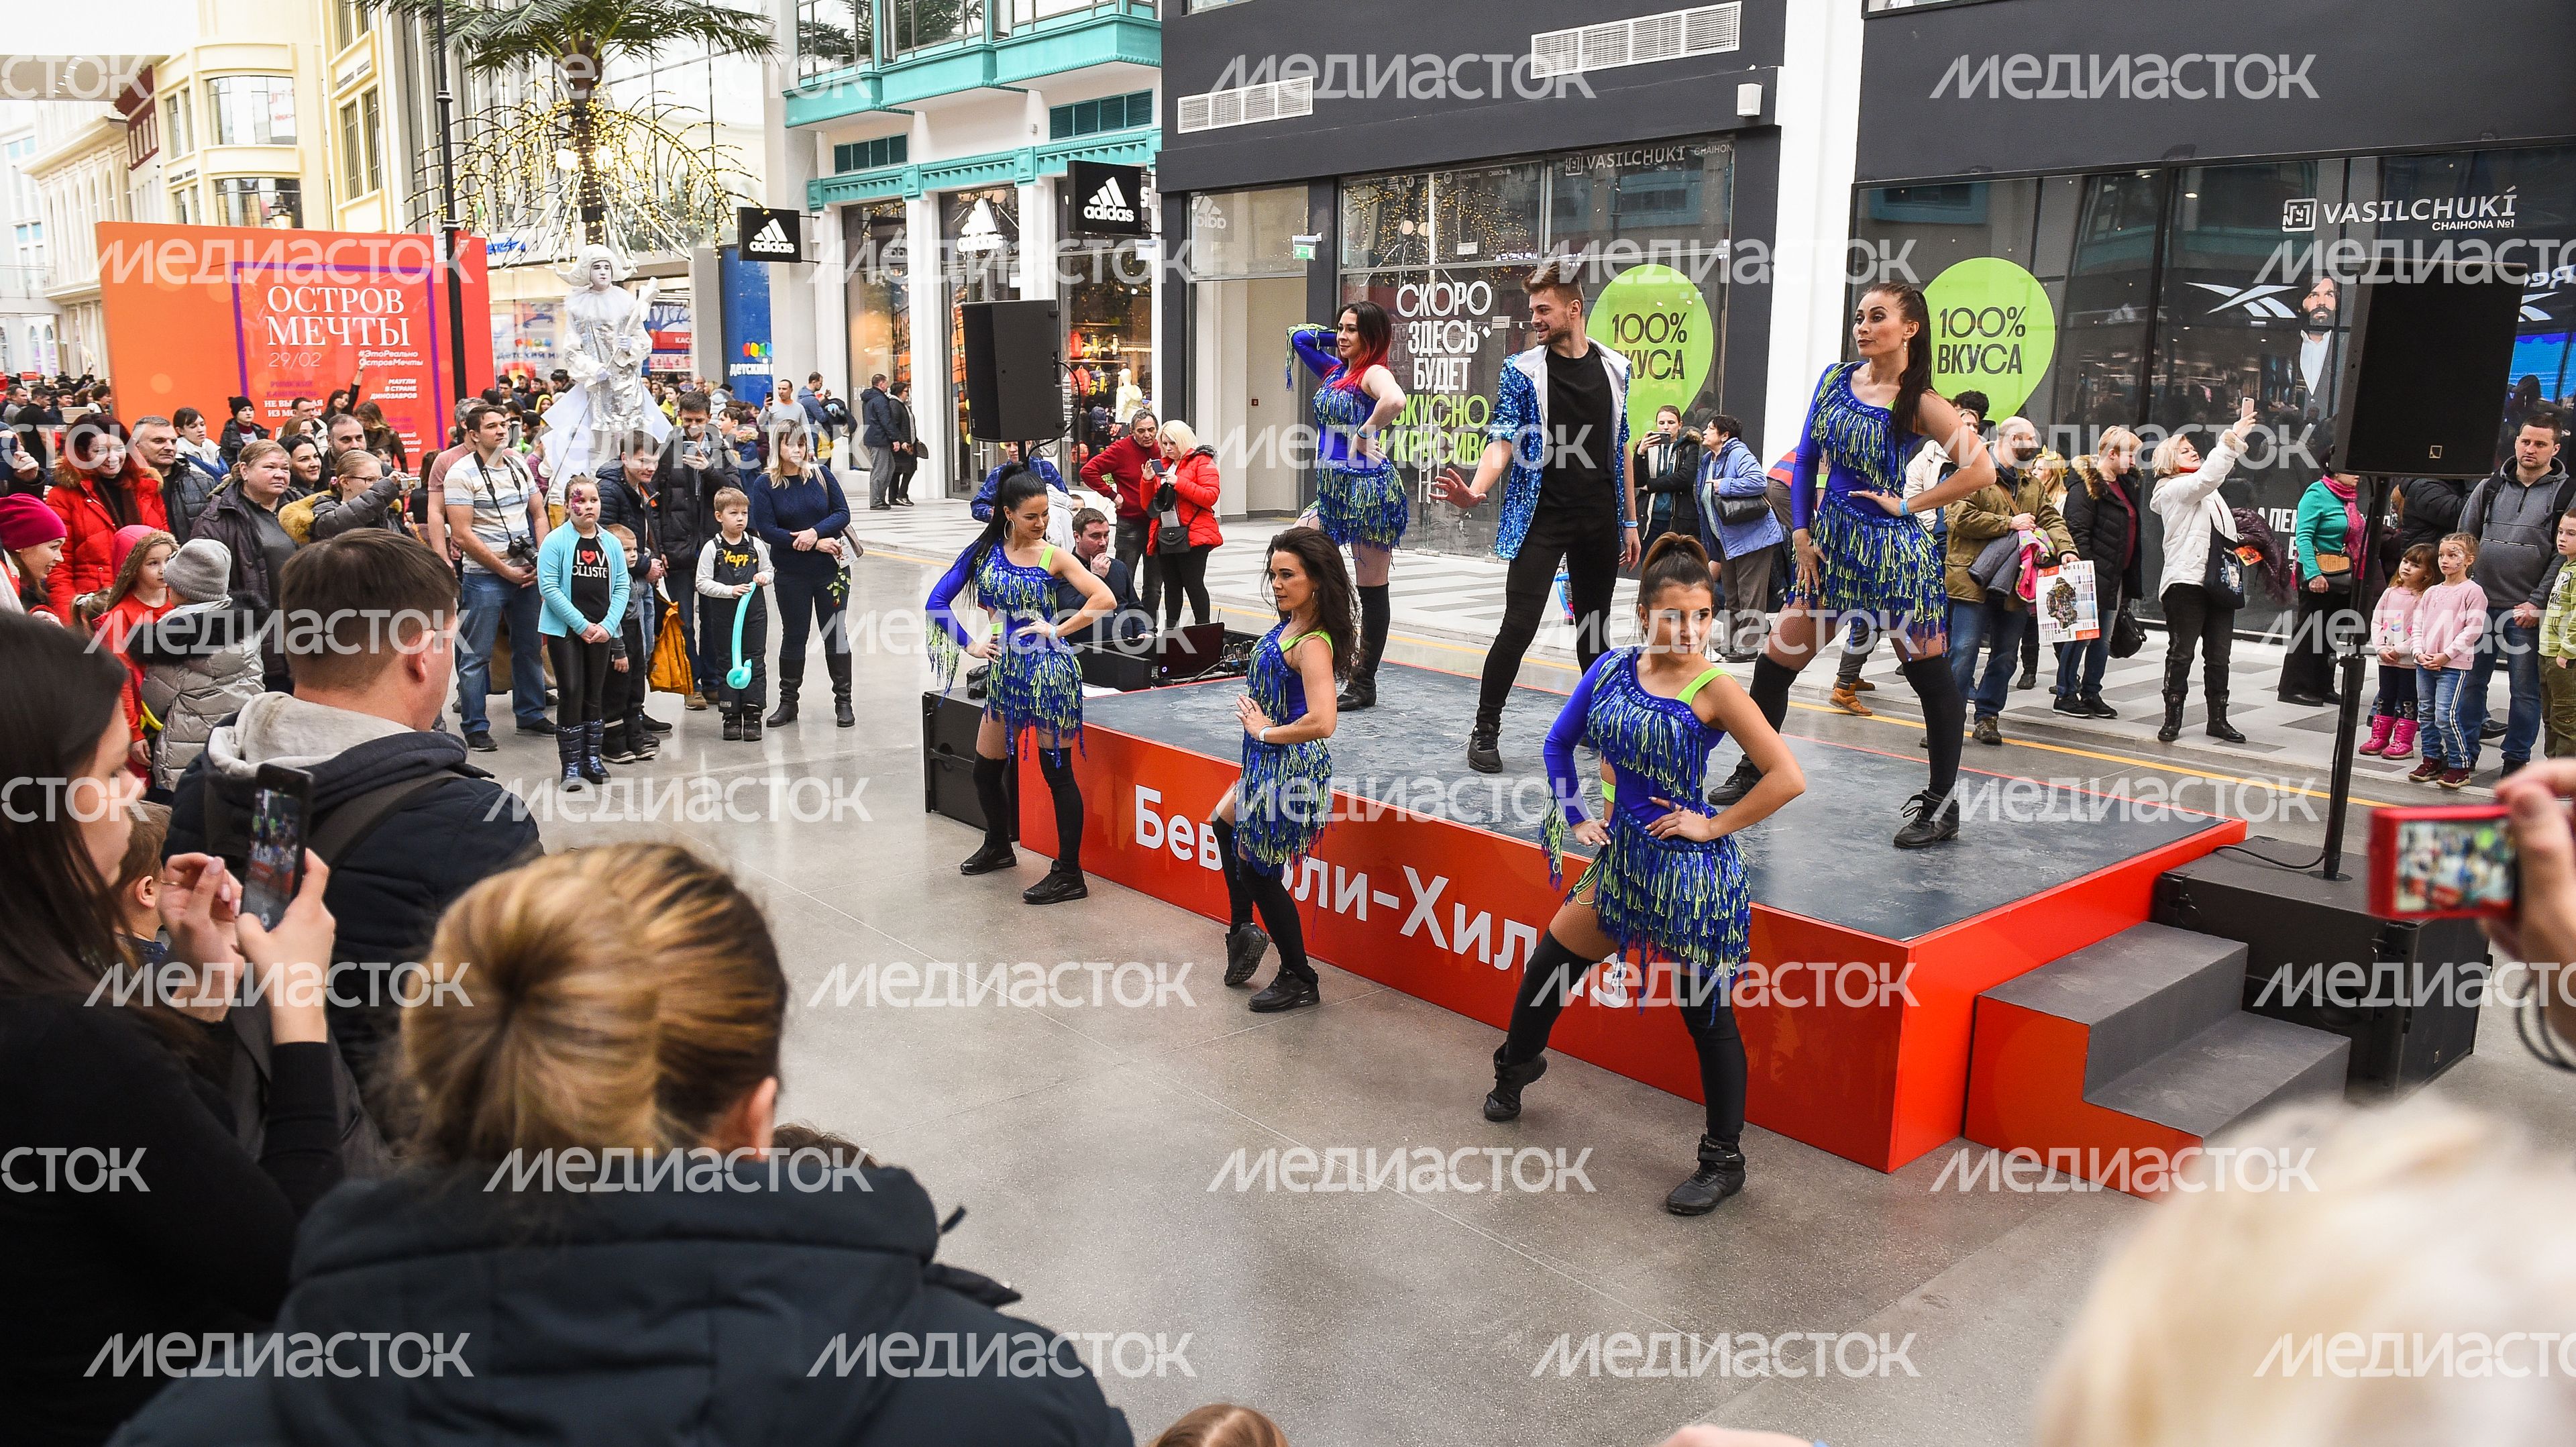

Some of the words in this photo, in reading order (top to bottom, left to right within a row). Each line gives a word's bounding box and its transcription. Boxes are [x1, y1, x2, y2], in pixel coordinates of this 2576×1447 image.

[1694, 144, 1733, 156] CHAIHON
[1083, 203, 1135, 223] adidas
[2432, 219, 2495, 231] CHAIHONA
[2497, 219, 2516, 229] №1
[749, 239, 795, 254] adidas
[957, 233, 1004, 252] adidas
[268, 286, 405, 315] ОСТРОВ
[1397, 280, 1493, 317] СКОРО
[265, 316, 411, 347] МЕЧТЫ
[1612, 312, 1687, 343] 100%
[1939, 306, 2027, 338] 100%
[1408, 319, 1479, 357] ЗДЕСЬ
[268, 352, 322, 370] 29/02
[358, 350, 419, 358] #ЭтоРеально
[358, 358, 424, 367] ОстровМечты
[1616, 349, 1685, 380] КУСА
[1937, 343, 2023, 375] ВКУСА
[1413, 357, 1471, 394] БУДЕТ
[572, 565, 608, 578] OLLISTE
[1136, 784, 1627, 1009] Бевли-Хилз
